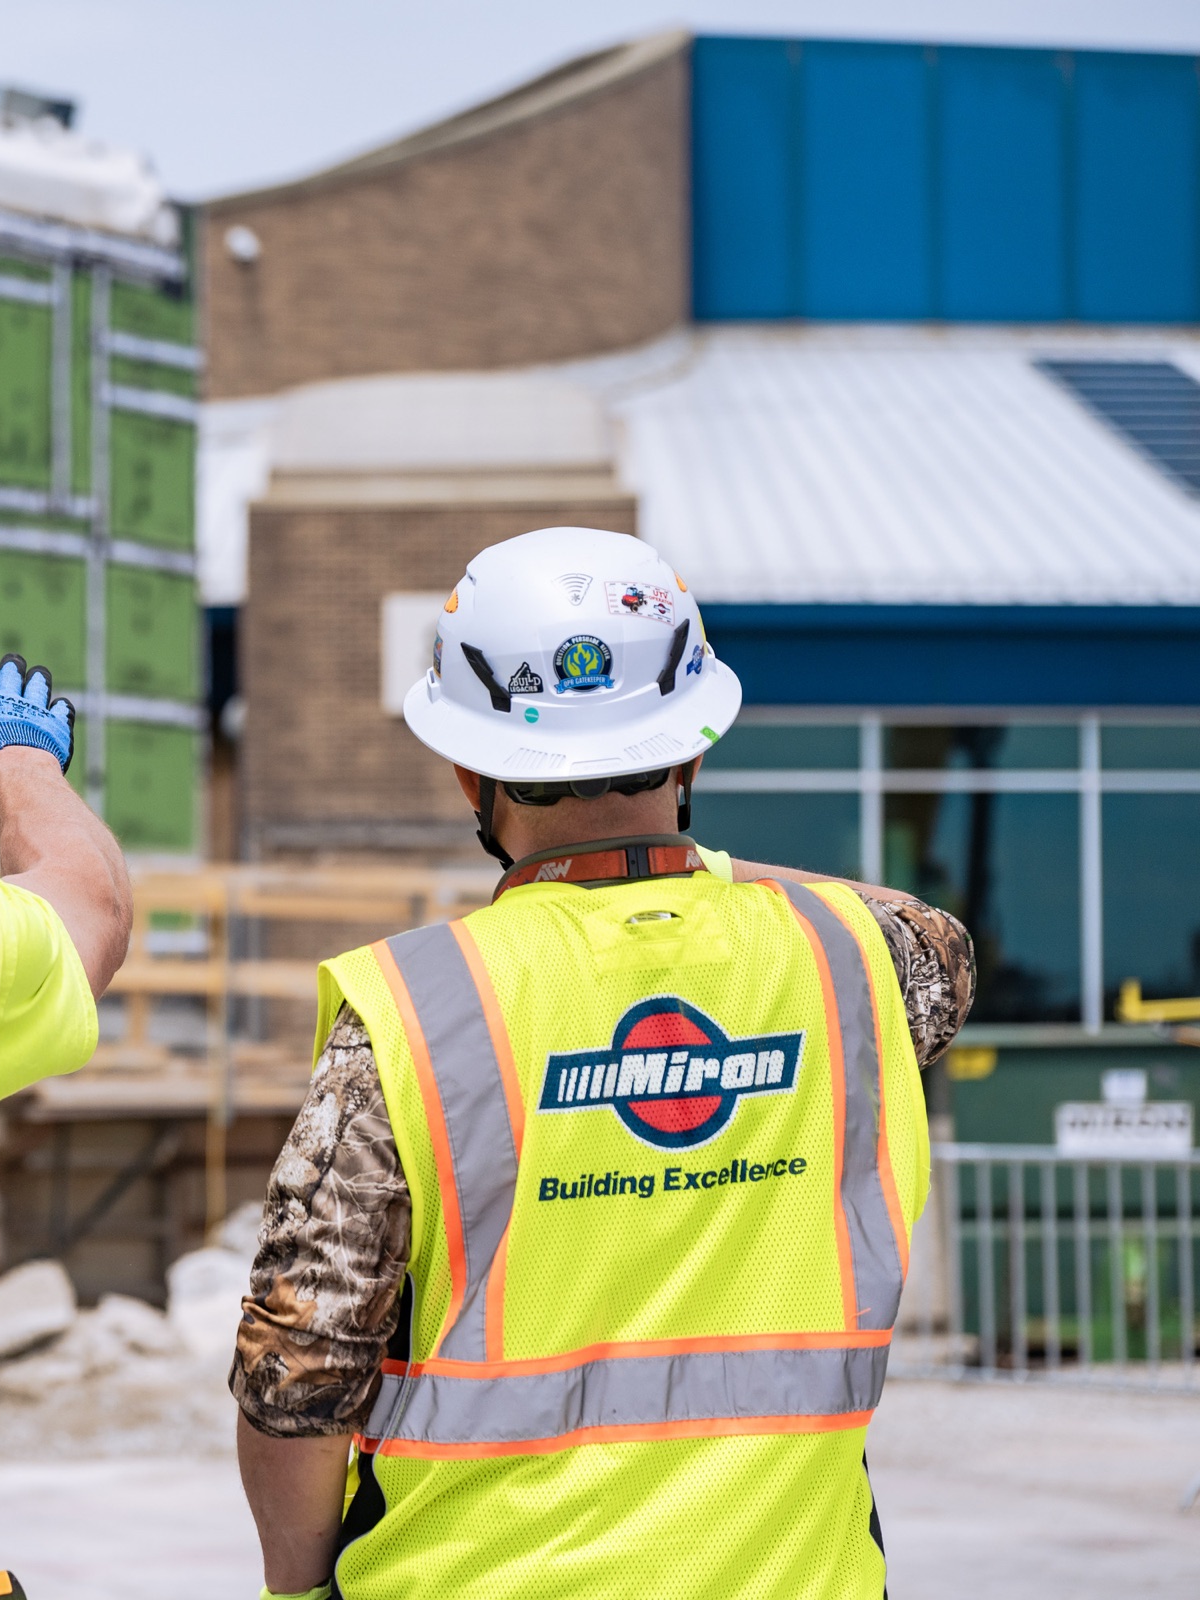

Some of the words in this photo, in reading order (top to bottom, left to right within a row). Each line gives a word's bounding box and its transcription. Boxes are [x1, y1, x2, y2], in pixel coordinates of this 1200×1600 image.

[653, 589, 668, 599] UTV
[648, 595, 673, 606] OPERATOR
[510, 673, 541, 687] BUILD
[575, 676, 605, 685] GATEKEEPER
[615, 1050, 785, 1098] Miron
[538, 1170, 655, 1200] Building
[663, 1157, 808, 1191] Excellence
